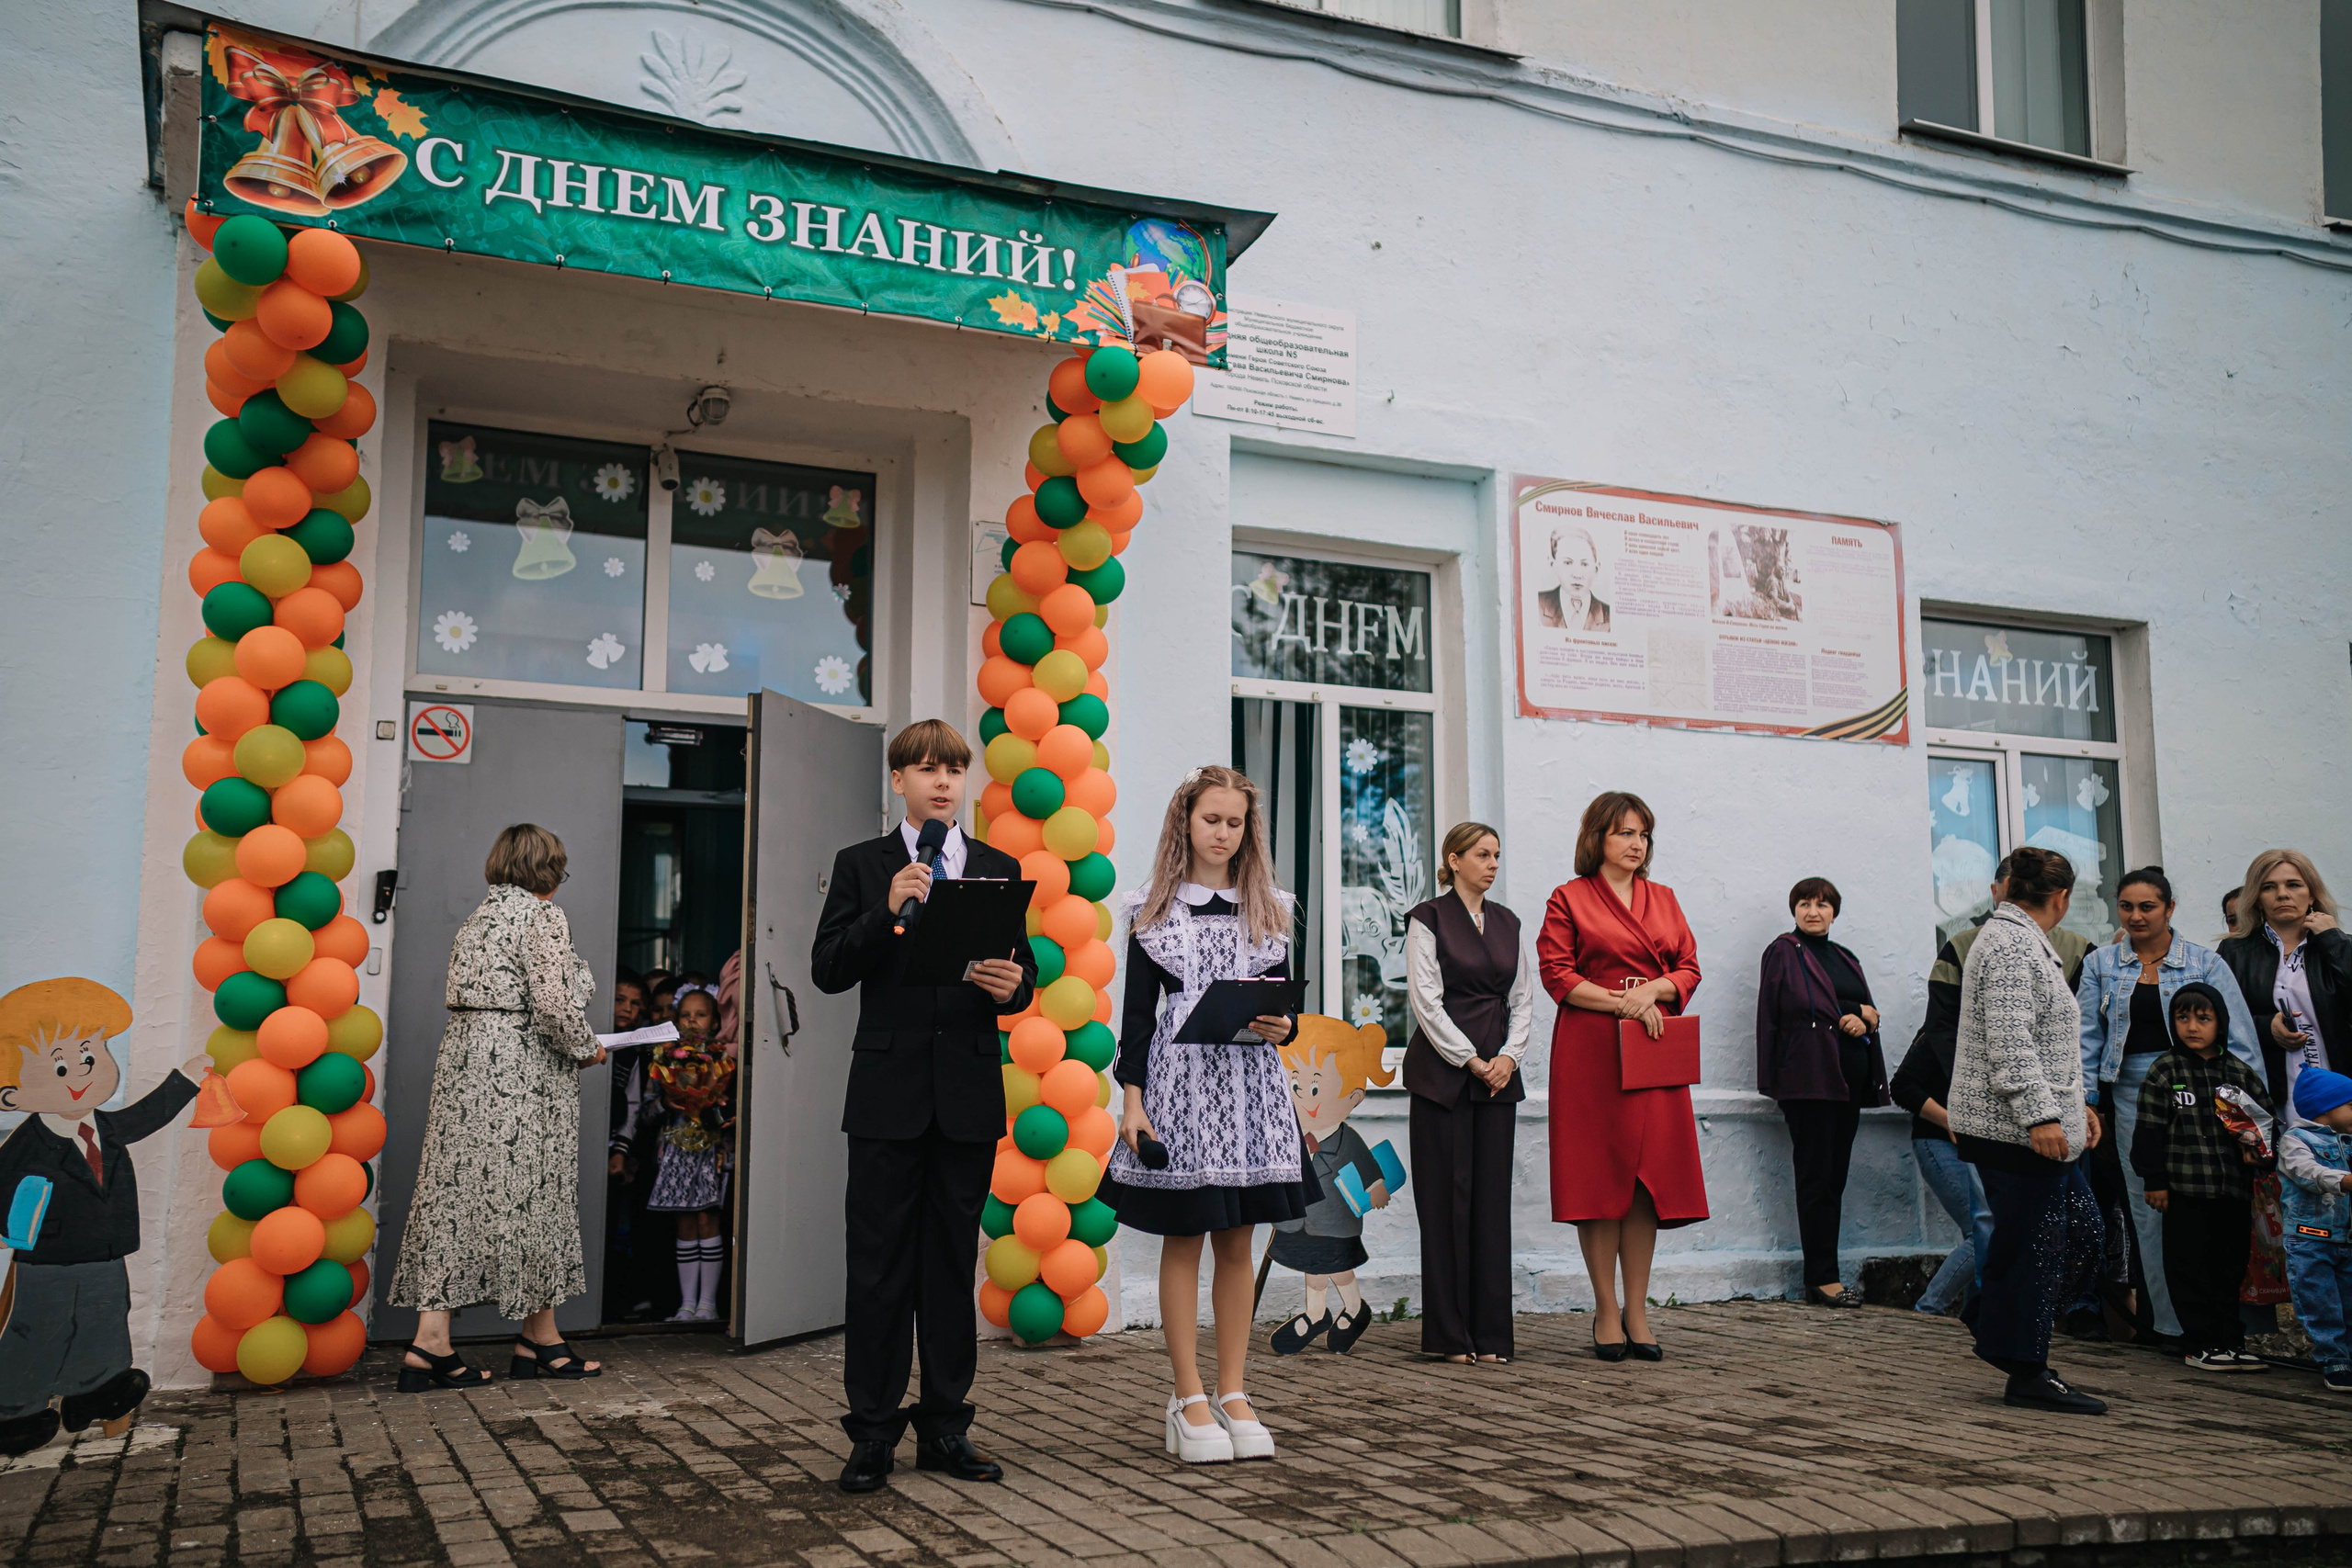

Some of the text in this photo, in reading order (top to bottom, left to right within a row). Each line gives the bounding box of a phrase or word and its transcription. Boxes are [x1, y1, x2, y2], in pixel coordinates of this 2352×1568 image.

[415, 137, 1076, 291] С ДНЕМ ЗНАНИЙ!
[1250, 334, 1349, 358] общеобразовательная
[1256, 346, 1297, 359] школа N5
[1249, 355, 1267, 363] Героя
[1269, 357, 1305, 369] Советского
[1306, 364, 1327, 373] Союза
[1249, 362, 1304, 378] Васильевича
[1303, 382, 1328, 392] области
[1253, 399, 1273, 408] Режим
[1535, 500, 1699, 531] Смирнов Вячеслав Васильевич
[1831, 536, 1863, 548] ПАМЯТЬ
[1272, 591, 1426, 660] ДНЕМ
[1923, 649, 2099, 712] НАНИЙ
